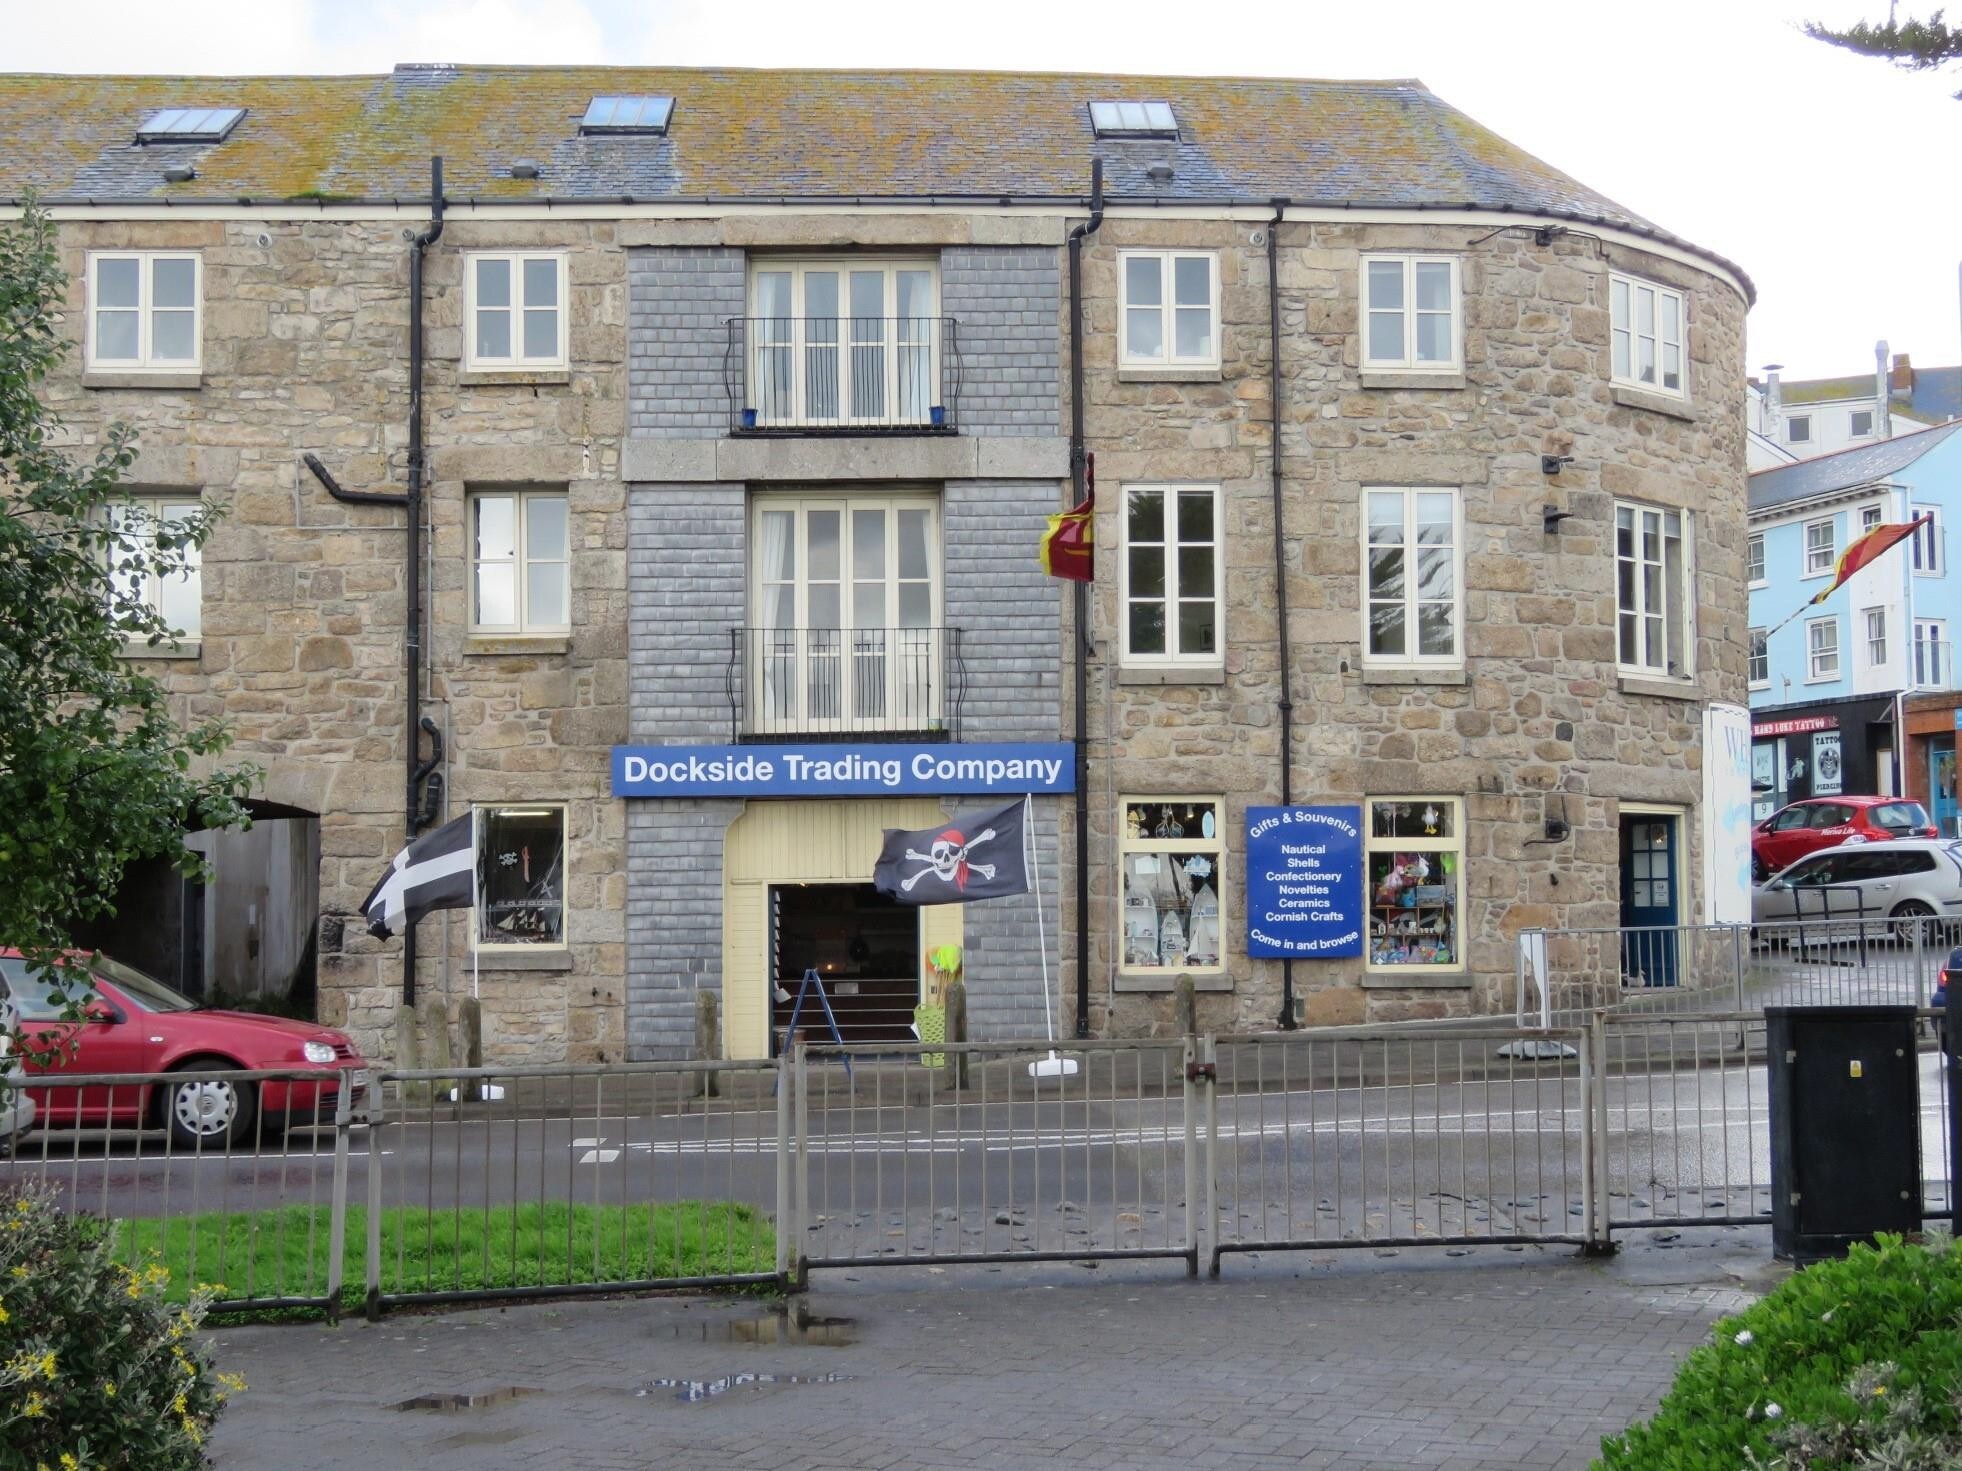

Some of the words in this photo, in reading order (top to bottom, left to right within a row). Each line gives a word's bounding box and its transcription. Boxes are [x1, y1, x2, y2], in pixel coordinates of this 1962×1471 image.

[1775, 721, 1794, 733] LUKE
[1795, 718, 1825, 731] TATTOO
[623, 756, 774, 784] Dockside
[784, 755, 901, 786] Trading
[911, 753, 1063, 785] Company
[1816, 783, 1841, 792] PIERCIN
[1761, 803, 1767, 814] 9
[1250, 817, 1280, 838] Gifts
[1282, 812, 1292, 823] &
[1295, 811, 1357, 837] Souvenirs
[1281, 845, 1326, 854] Nautical
[1287, 858, 1320, 868] Shells
[1266, 871, 1341, 883] Confectionery
[1279, 885, 1329, 895] Novelties
[1279, 898, 1330, 908] Ceramics
[1265, 912, 1307, 922] Cornish
[1310, 911, 1344, 921] Crafts
[1251, 929, 1281, 948] Come
[1284, 939, 1293, 949] in
[1297, 940, 1317, 950] and
[1320, 931, 1358, 948] browse
